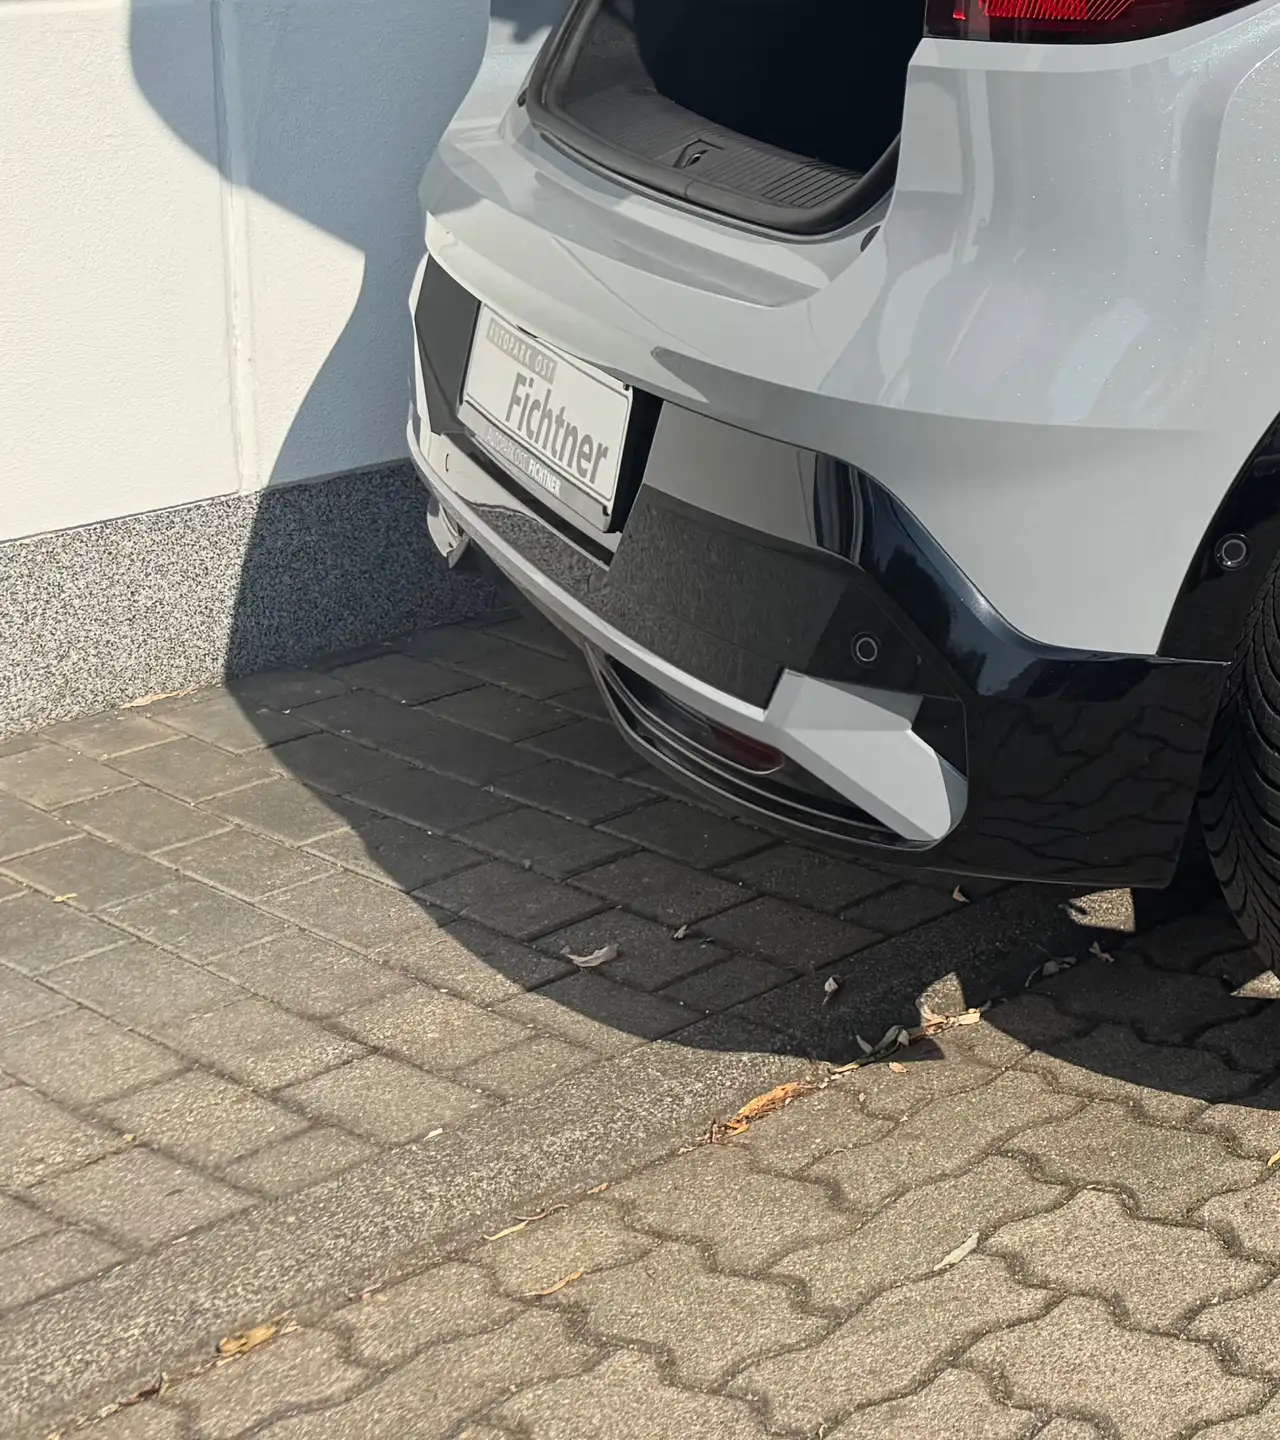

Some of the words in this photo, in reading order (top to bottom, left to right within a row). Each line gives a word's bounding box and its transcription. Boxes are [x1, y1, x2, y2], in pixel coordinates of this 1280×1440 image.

[488, 322, 532, 365] AUTOPARK
[535, 357, 554, 377] OST
[505, 372, 608, 485] Fichtner
[528, 459, 562, 497] FICHTNER
